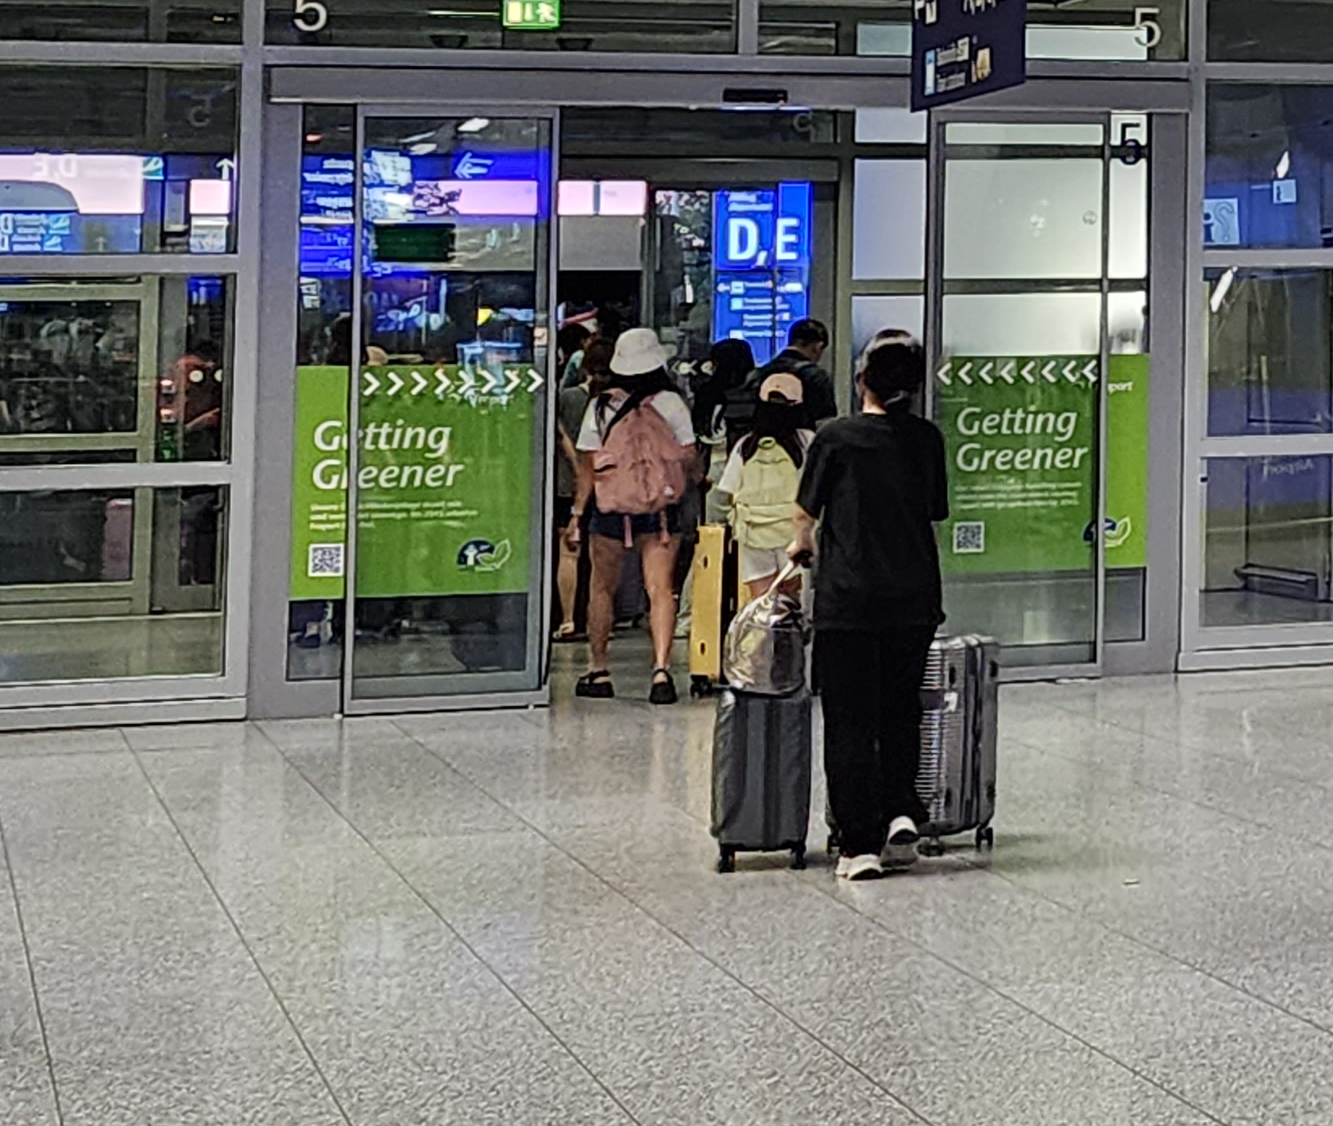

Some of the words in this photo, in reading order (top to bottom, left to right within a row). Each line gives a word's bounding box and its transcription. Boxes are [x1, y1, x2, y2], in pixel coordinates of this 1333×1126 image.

[1134, 7, 1162, 47] 5
[728, 217, 800, 266] D,E
[956, 405, 1078, 442] Getting
[956, 443, 1089, 472] Greener
